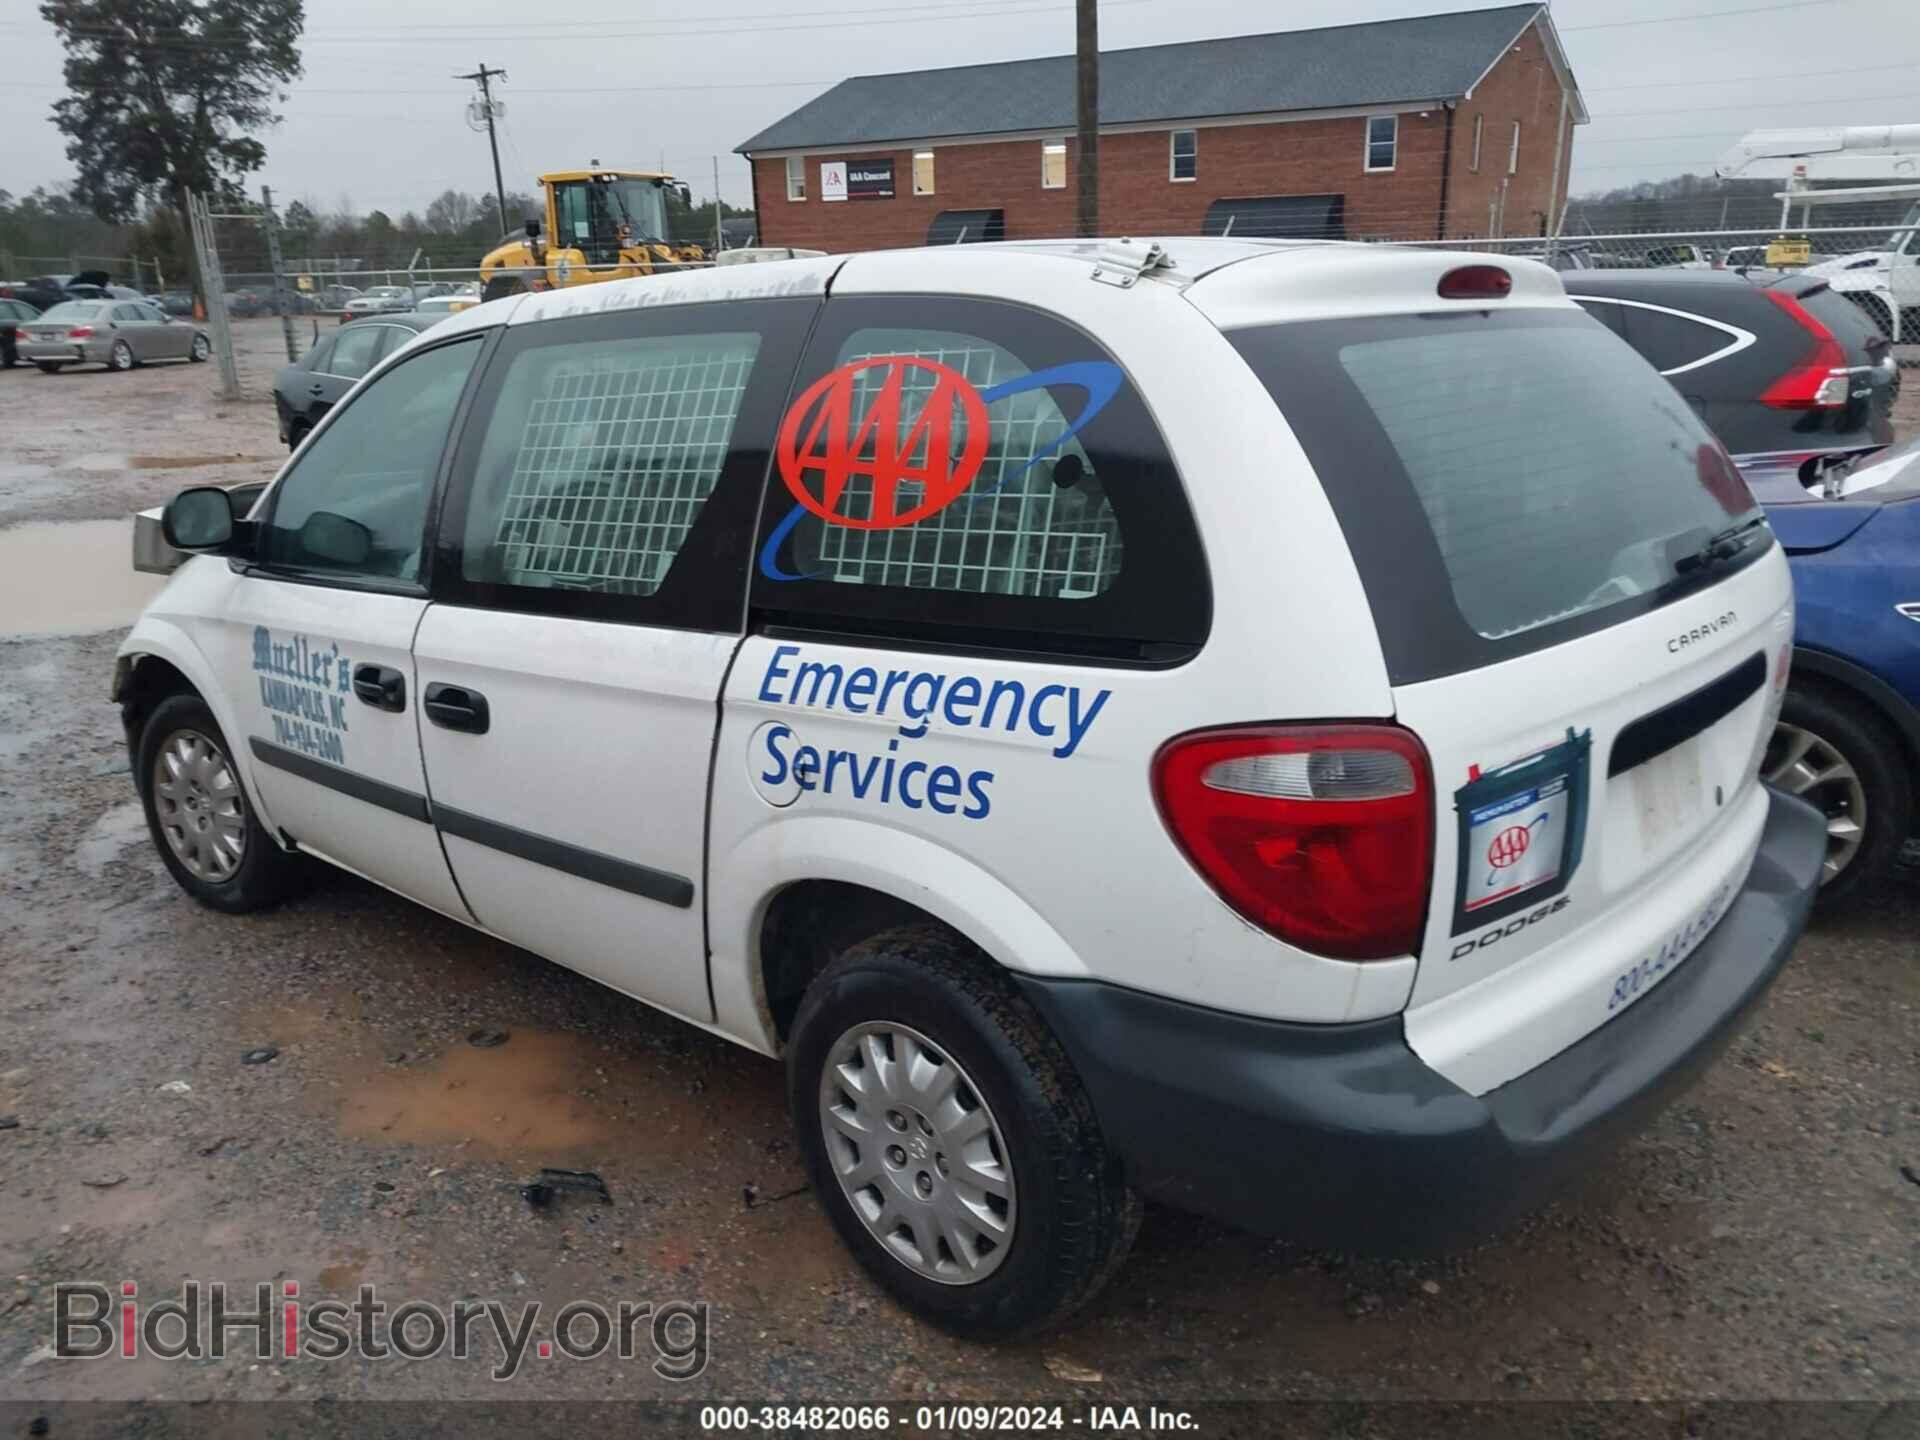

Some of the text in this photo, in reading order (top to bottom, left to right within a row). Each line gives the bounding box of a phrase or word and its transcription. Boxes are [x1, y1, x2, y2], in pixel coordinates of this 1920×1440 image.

[783, 356, 977, 528] AAA
[253, 624, 350, 692] Mueller's
[1667, 611, 1738, 653] CARAVAN
[758, 646, 1112, 758] Emergency
[762, 726, 994, 819] Services
[1489, 826, 1529, 868] AAA
[1450, 896, 1571, 961] DODGE
